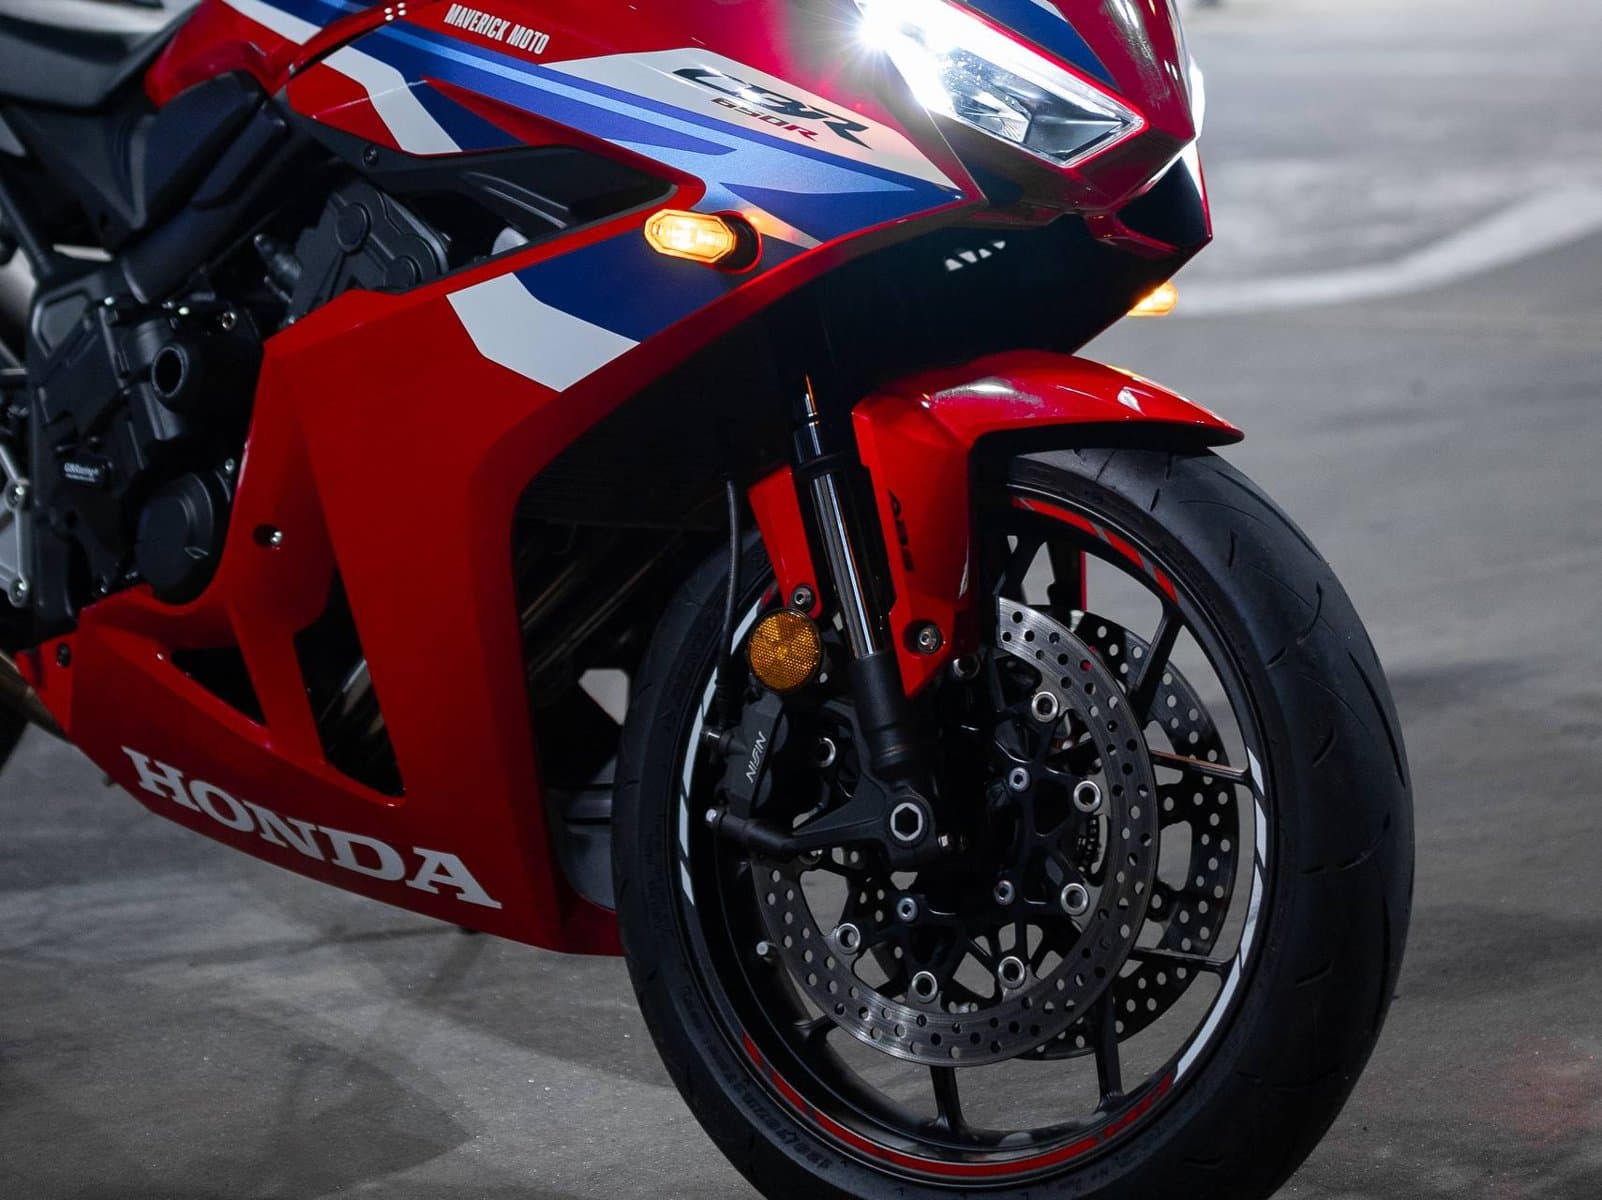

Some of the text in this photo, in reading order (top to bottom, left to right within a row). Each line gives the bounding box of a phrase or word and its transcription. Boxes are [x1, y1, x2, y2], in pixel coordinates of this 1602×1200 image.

[443, 3, 550, 55] MAVERICK MOTO
[672, 68, 873, 151] CBR
[711, 97, 819, 142] 650R
[745, 729, 767, 784] NISSIN
[120, 745, 503, 910] HONDA
